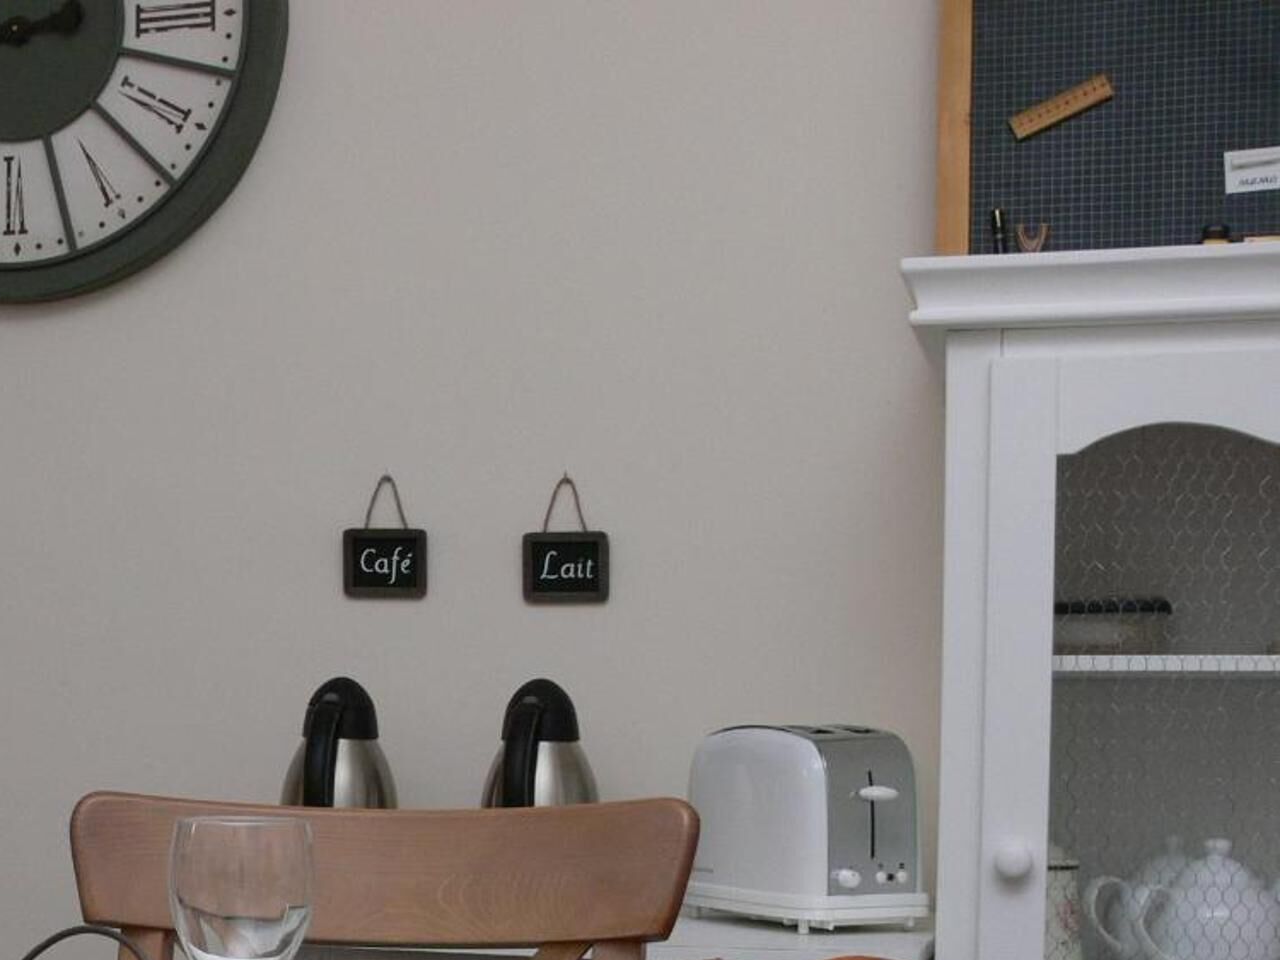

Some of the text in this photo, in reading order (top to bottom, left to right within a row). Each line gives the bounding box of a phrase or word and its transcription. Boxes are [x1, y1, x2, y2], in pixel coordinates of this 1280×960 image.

[119, 76, 192, 134] IV
[3, 153, 28, 236] VI
[76, 135, 122, 207] V
[359, 546, 414, 584] Café
[540, 550, 594, 580] Lait
